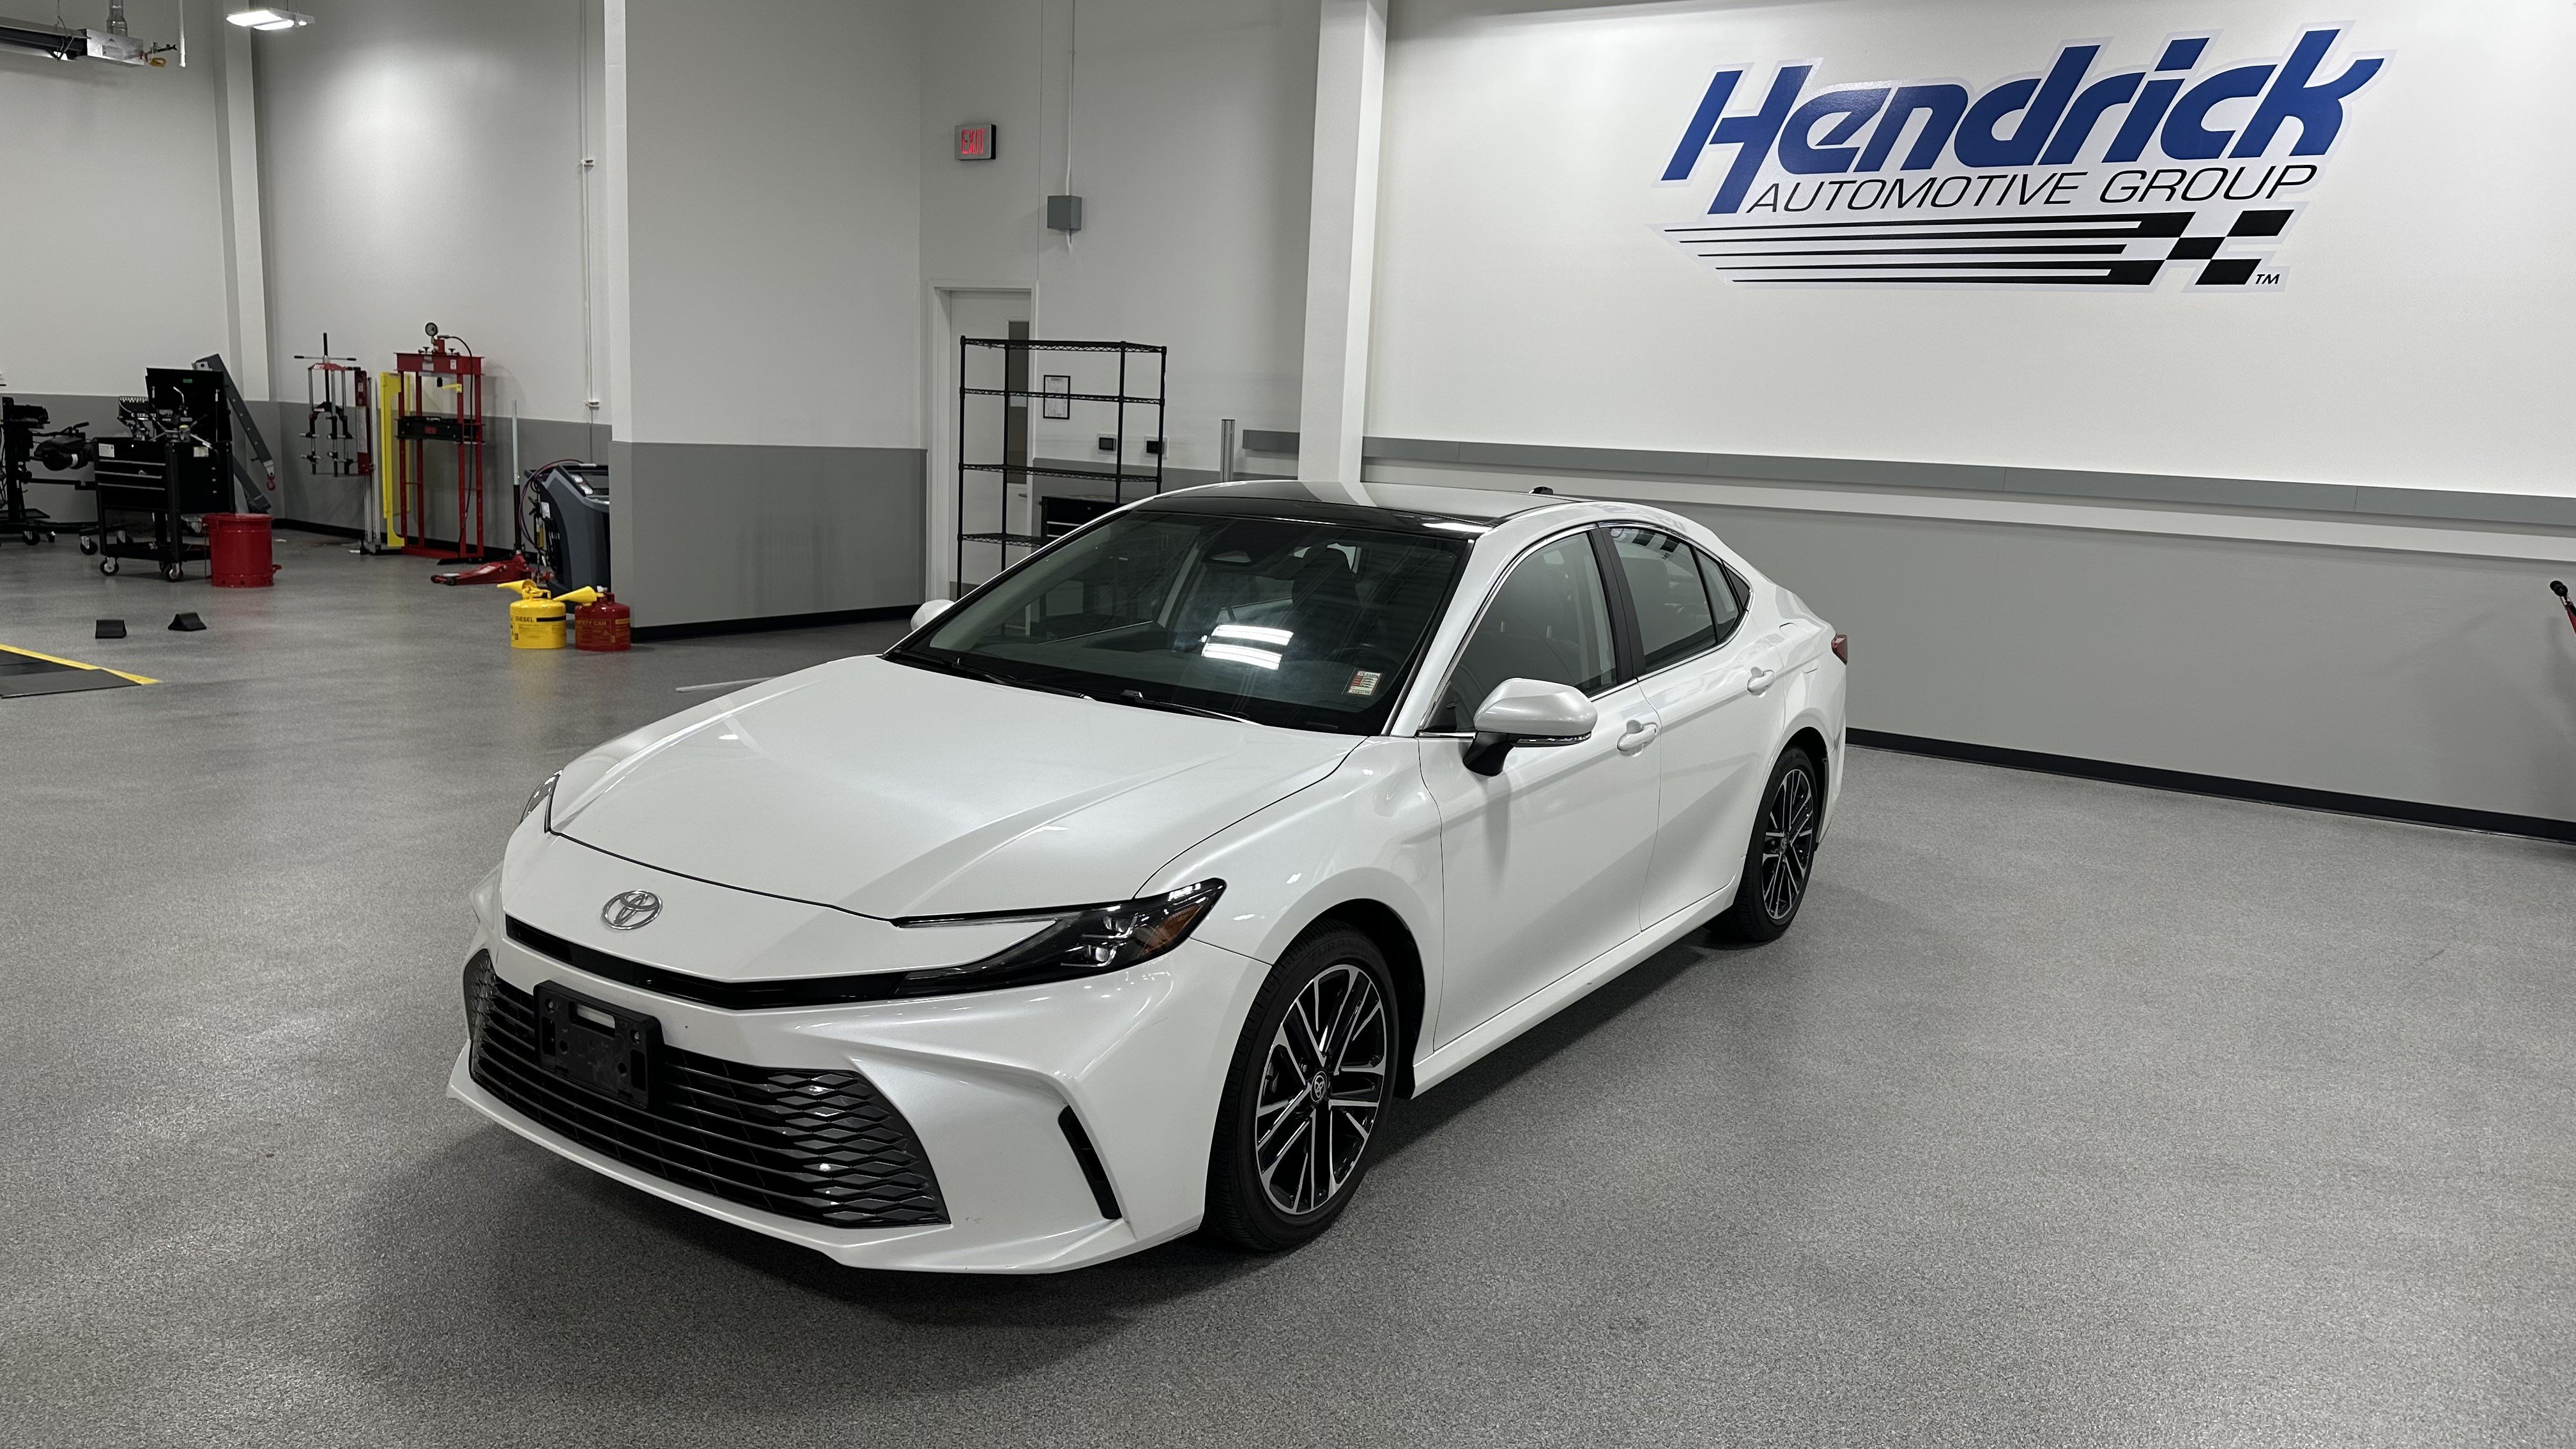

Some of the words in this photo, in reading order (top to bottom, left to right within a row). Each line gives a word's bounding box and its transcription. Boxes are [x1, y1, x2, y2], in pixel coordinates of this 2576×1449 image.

[1661, 29, 2384, 214] Hendrick
[961, 128, 985, 155] EXIT
[1745, 171, 2089, 213] AUTOMOTIVE
[2099, 164, 2318, 203] GROUP
[2255, 274, 2280, 284] TM
